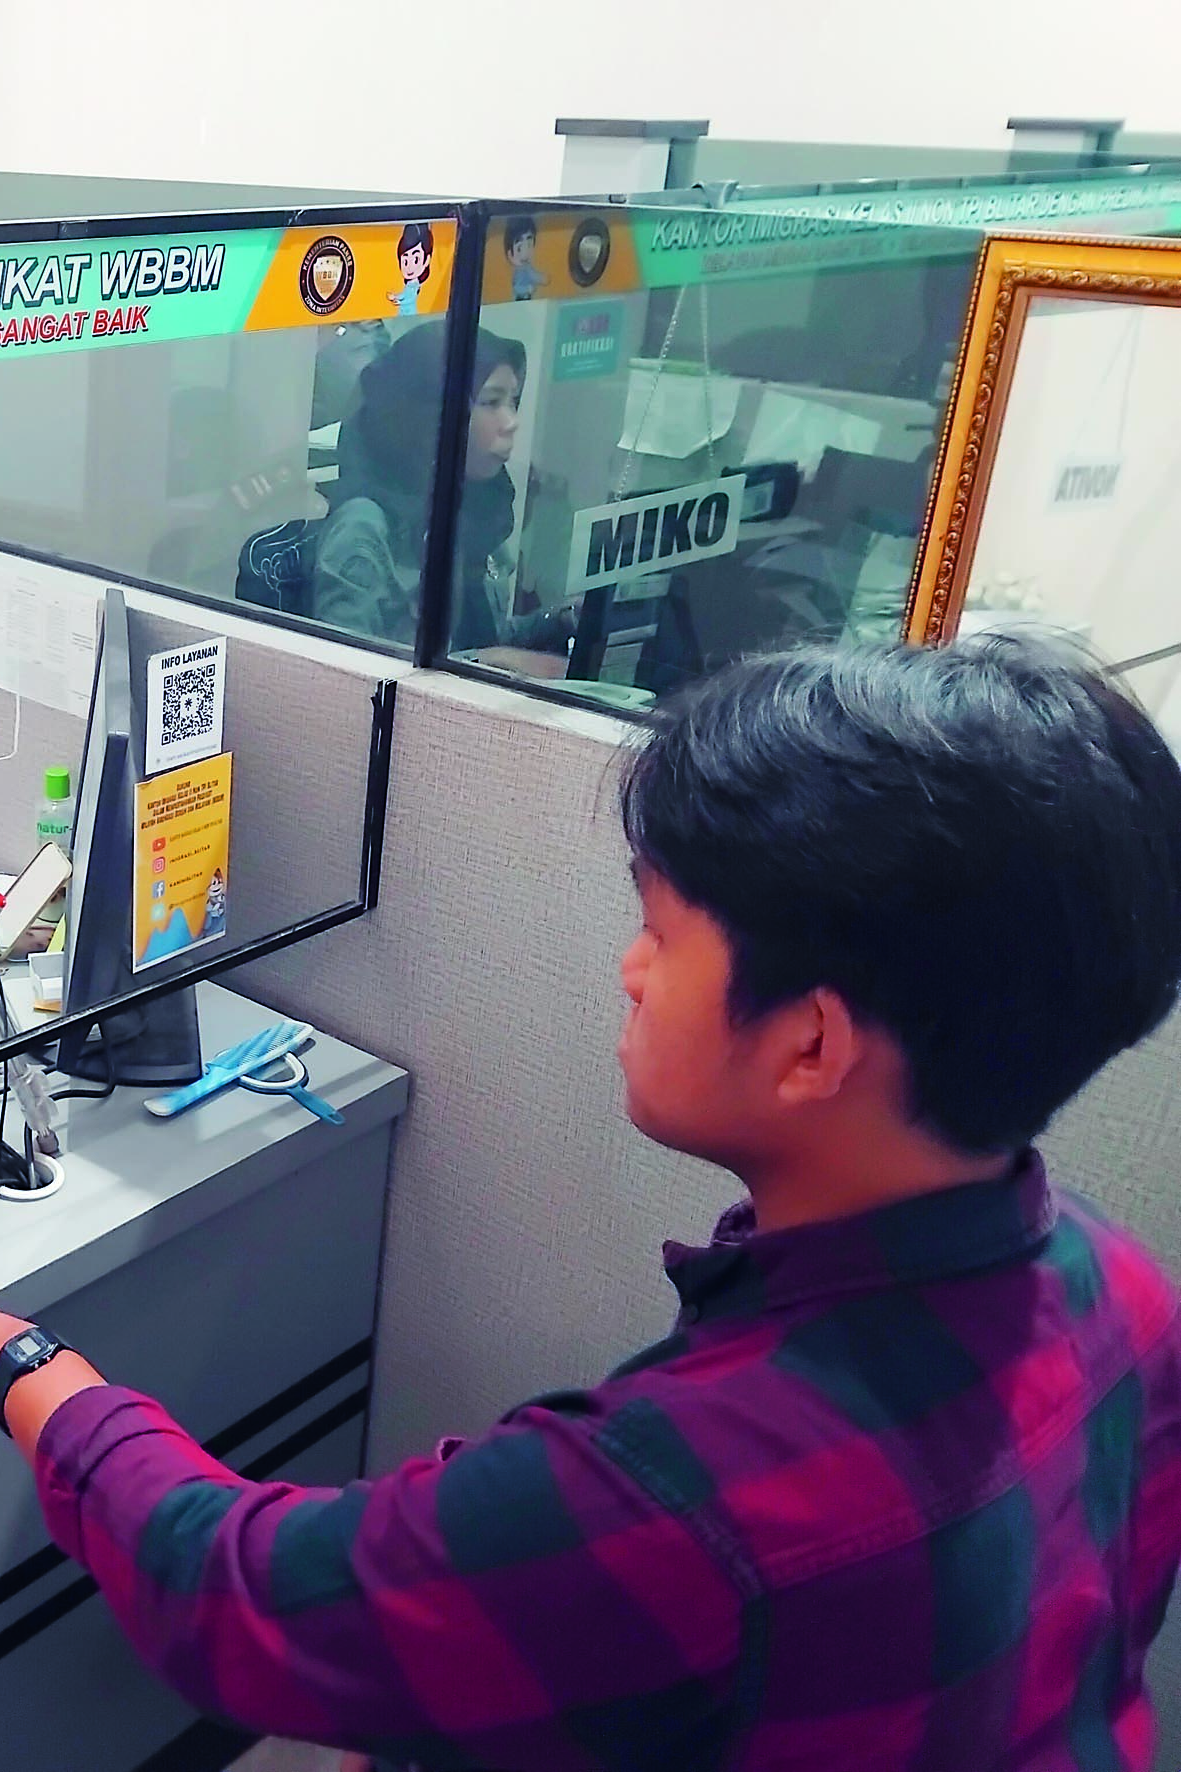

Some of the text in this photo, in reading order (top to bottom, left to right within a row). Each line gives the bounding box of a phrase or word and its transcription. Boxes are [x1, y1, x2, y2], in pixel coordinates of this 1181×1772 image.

[651, 211, 746, 252] KANTOR
[100, 244, 225, 300] WBBM
[92, 305, 151, 335] BAIK
[586, 492, 730, 577] MIKO
[161, 645, 219, 670] INFO LAYANAN
